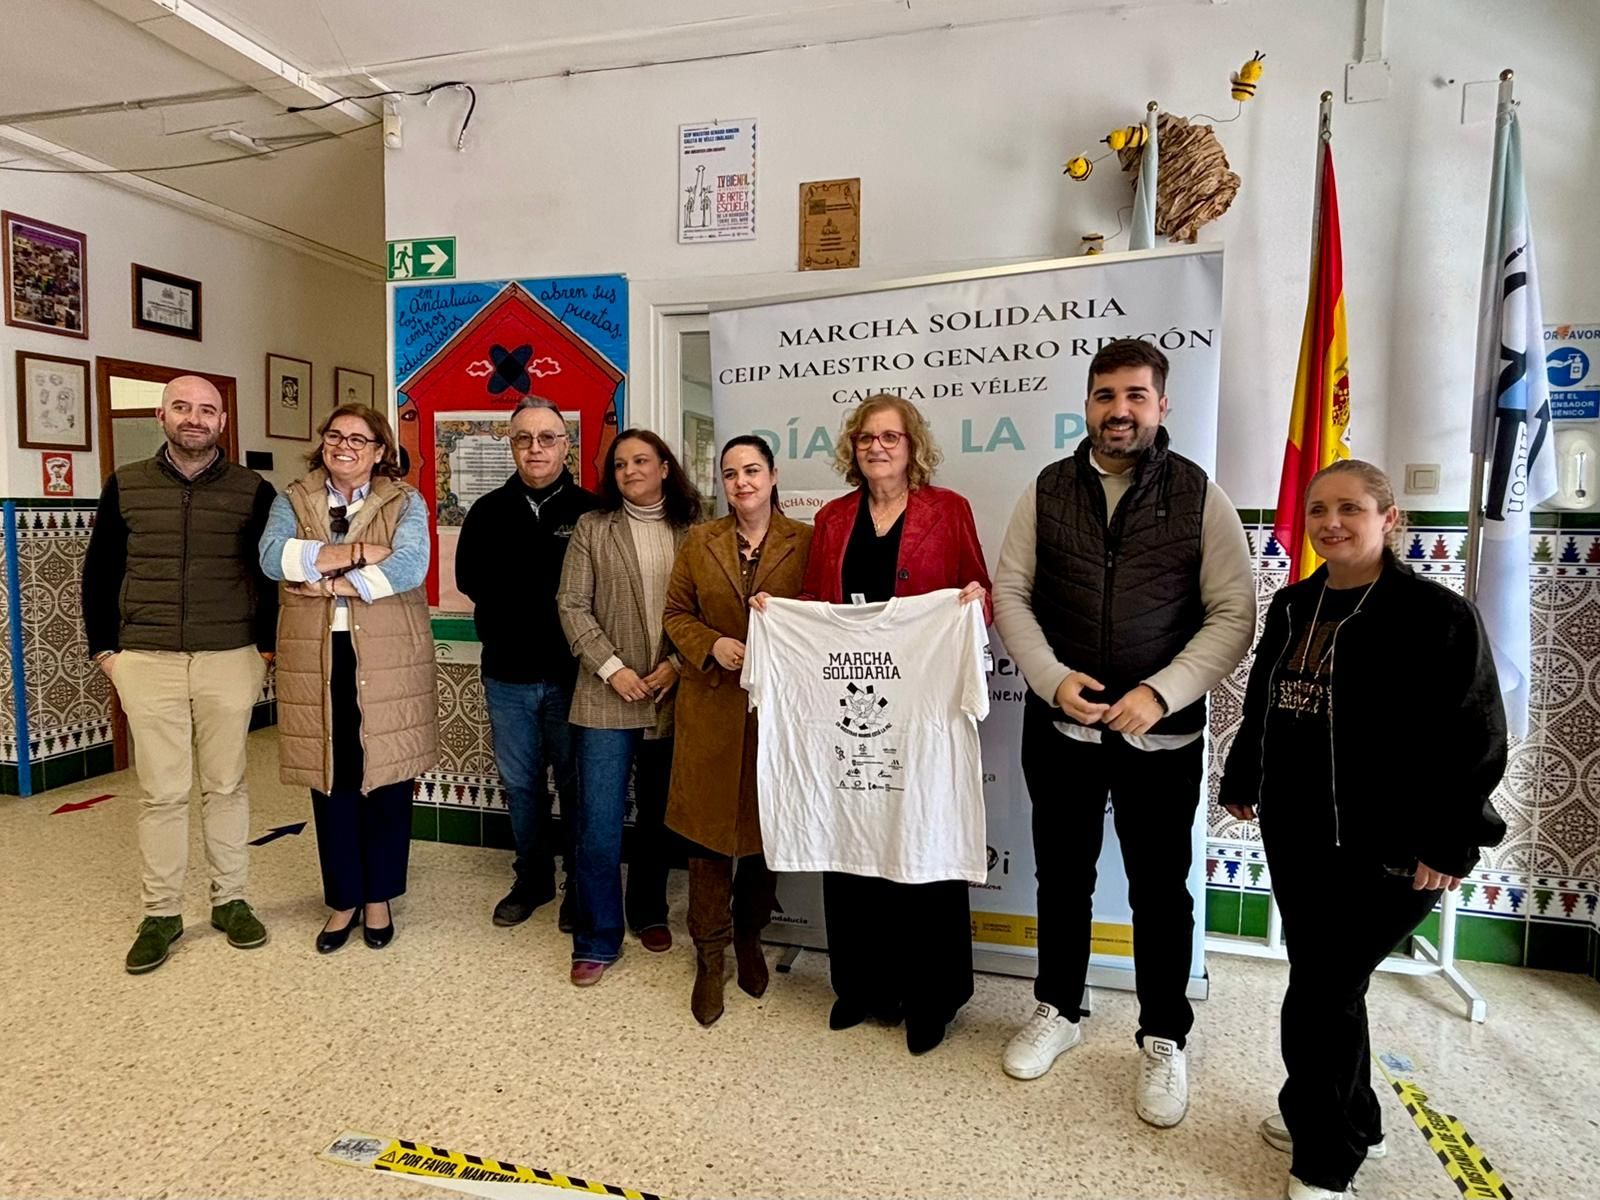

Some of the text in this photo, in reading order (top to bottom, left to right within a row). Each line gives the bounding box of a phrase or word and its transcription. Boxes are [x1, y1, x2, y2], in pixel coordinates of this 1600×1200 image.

[726, 174, 750, 187] BIENAL
[717, 193, 726, 202] DE
[727, 191, 744, 201] ARTE
[717, 201, 749, 213] ESCUELA
[417, 288, 433, 300] en
[540, 282, 617, 304] abren sus
[398, 311, 418, 329] los
[778, 297, 1127, 348] MARCHA SOLIDARIA
[405, 311, 447, 346] centros
[1543, 330, 1558, 340] OR
[397, 315, 465, 377] educativos
[719, 365, 771, 385] CEIP
[778, 352, 914, 380] MAESTRO
[924, 340, 1060, 368] GENARO
[933, 382, 964, 399] DE
[971, 376, 1048, 396] VÉLEZ
[1551, 400, 1595, 408] ENSADOR
[1567, 392, 1579, 400] EL
[961, 416, 1025, 454] LA
[828, 651, 894, 666] MARCHA
[823, 665, 901, 680] SOLIDARIA
[1436, 1131, 1459, 1144] DE
[397, 1152, 420, 1166] POR
[419, 1157, 458, 1178] FAVOR,
[1445, 1144, 1489, 1187] DISTANCIA
